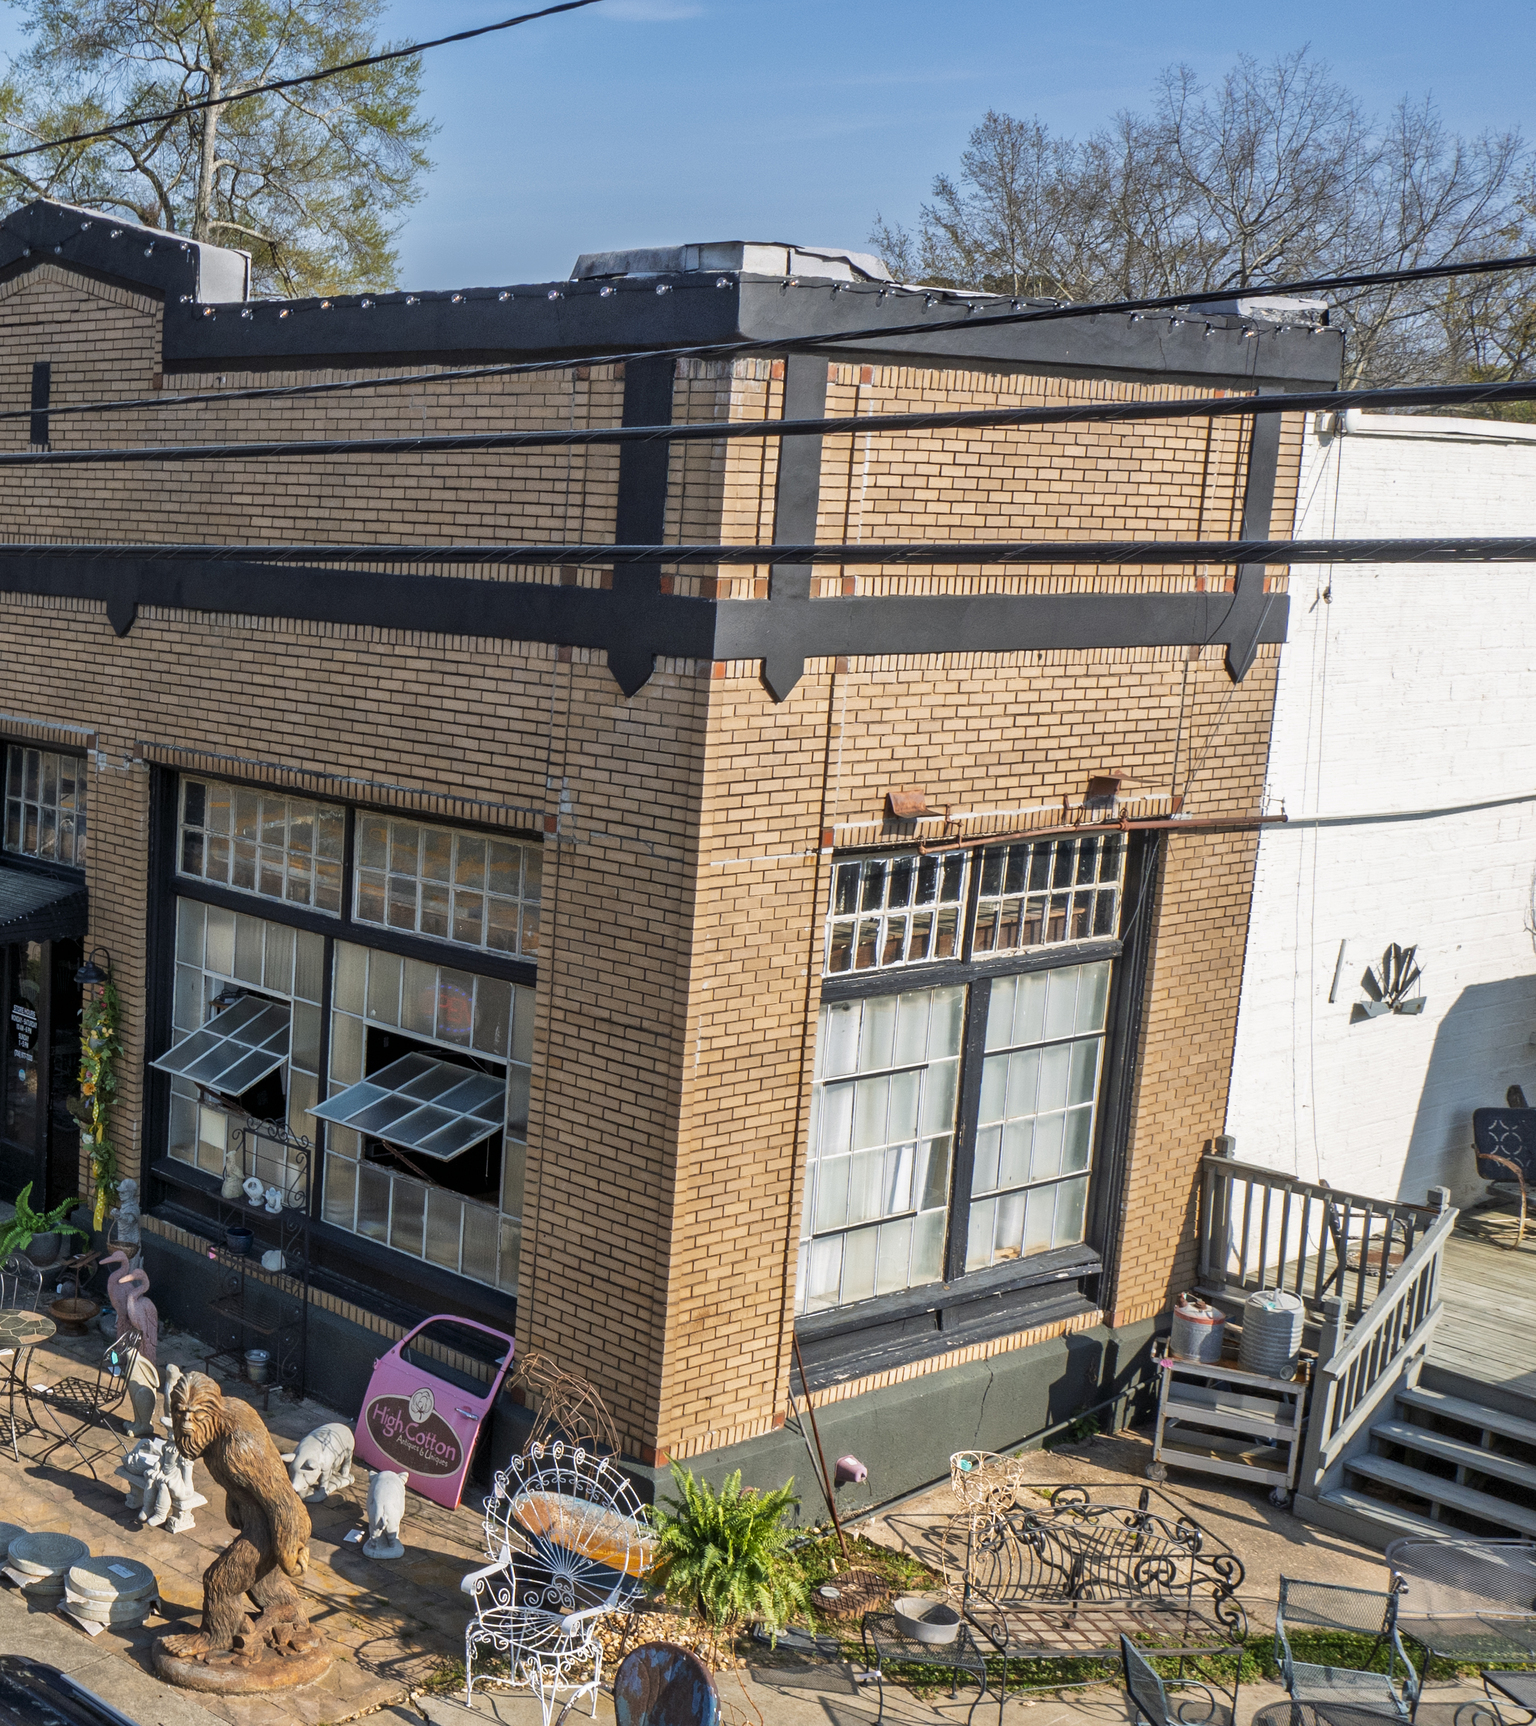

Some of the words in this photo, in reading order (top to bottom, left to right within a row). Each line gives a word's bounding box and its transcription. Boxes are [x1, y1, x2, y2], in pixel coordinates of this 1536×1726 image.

[372, 1403, 403, 1437] High
[406, 1422, 456, 1461] Cotton
[396, 1434, 419, 1452] Antiques
[424, 1449, 448, 1467] Uniques
